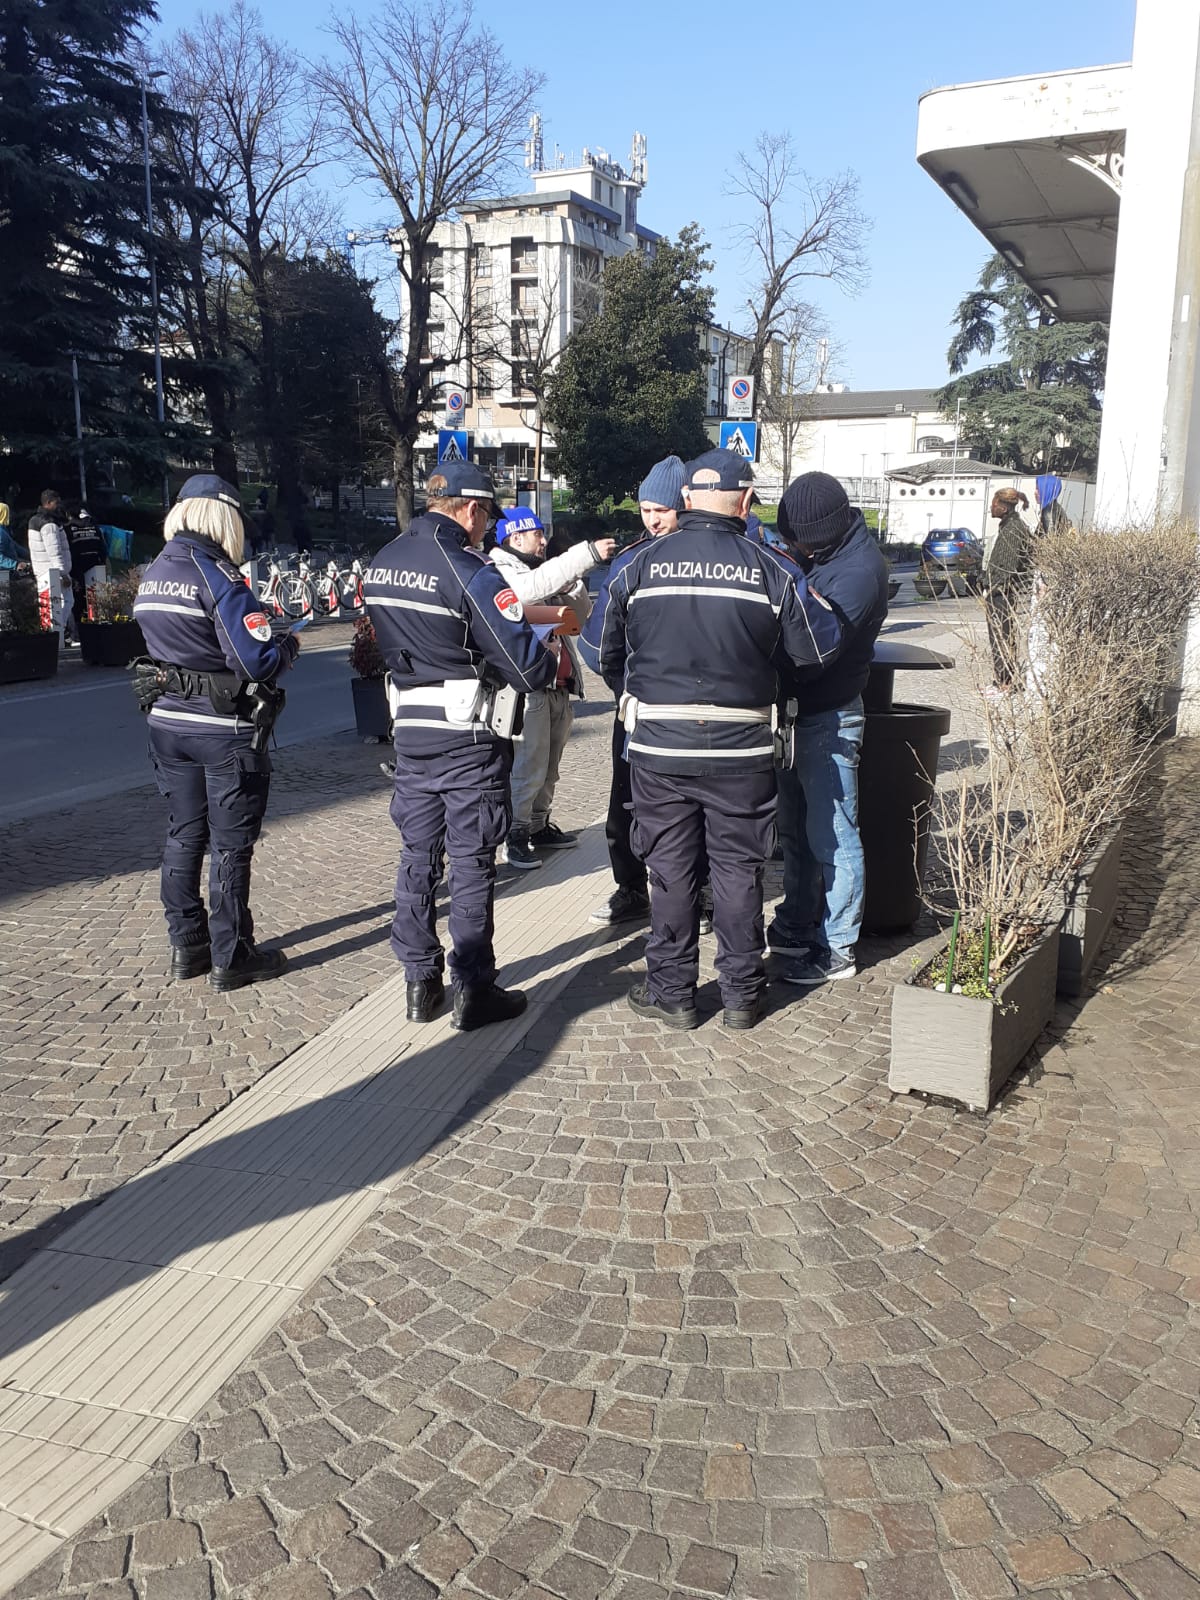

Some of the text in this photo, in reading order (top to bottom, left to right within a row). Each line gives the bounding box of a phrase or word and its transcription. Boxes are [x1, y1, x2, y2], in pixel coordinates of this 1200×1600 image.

[505, 517, 536, 534] MILANO
[393, 569, 439, 592] LOCALE
[650, 561, 761, 585] POLIZIA LOCALE
[158, 580, 198, 600] LOCALE
